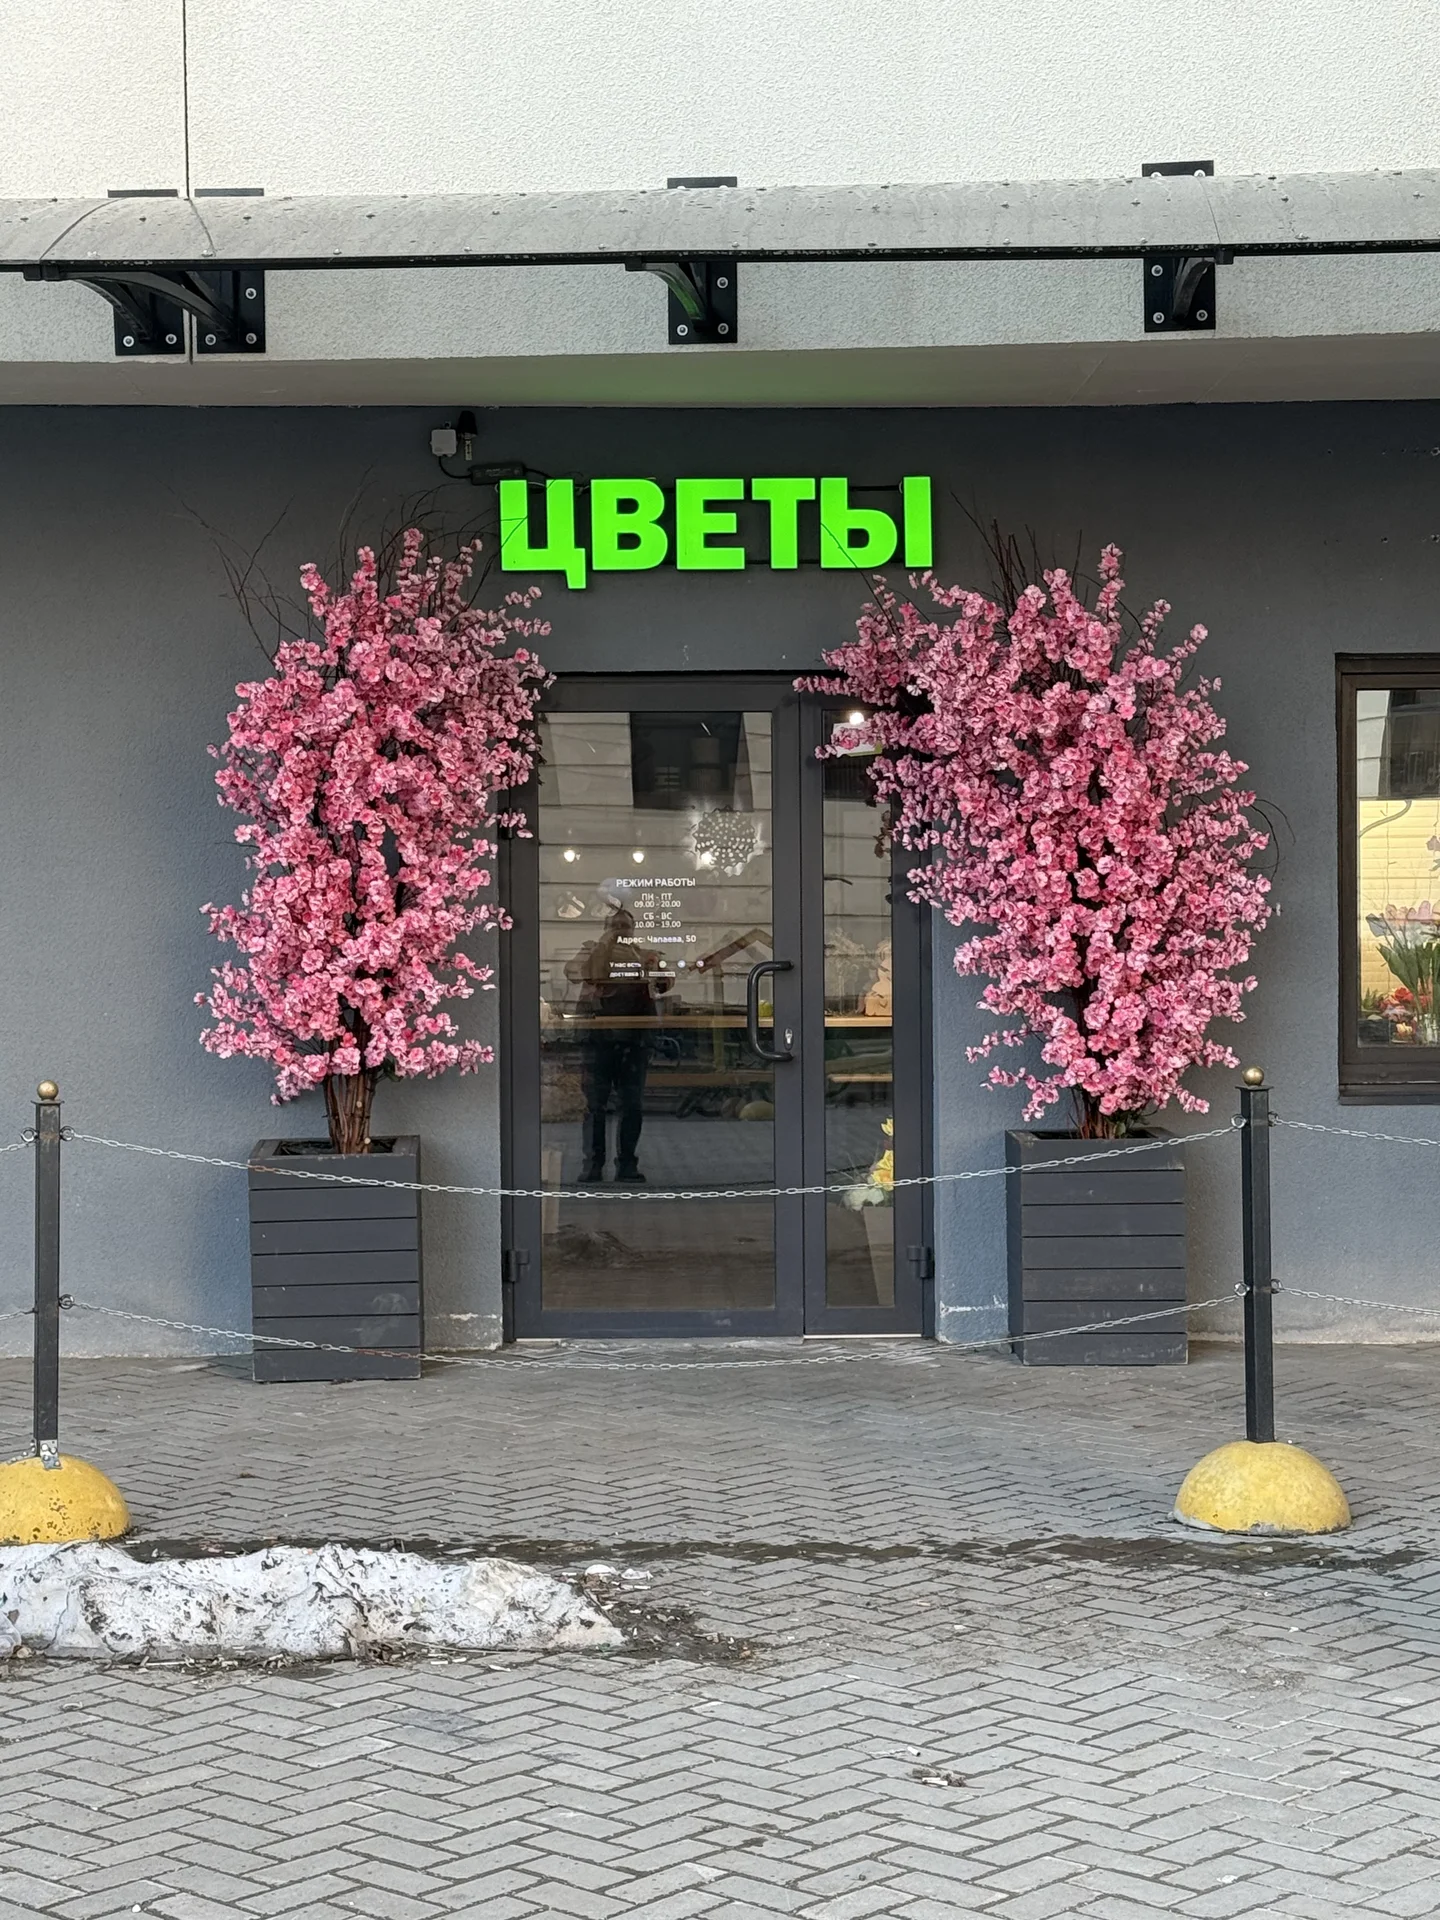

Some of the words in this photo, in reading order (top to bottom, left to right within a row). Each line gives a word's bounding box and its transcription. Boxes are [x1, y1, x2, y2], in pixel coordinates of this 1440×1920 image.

[498, 475, 932, 590] ЦВЕТЫ
[616, 878, 653, 887] РЕЖИМ
[655, 877, 696, 887] РАБОТЫ
[641, 893, 654, 901] ПН
[661, 893, 673, 901] ПТ
[643, 912, 654, 920] СБ
[661, 912, 673, 920] ВС
[617, 936, 645, 945] Адрес:
[647, 936, 684, 944] Чапаева,
[685, 935, 697, 943] 50
